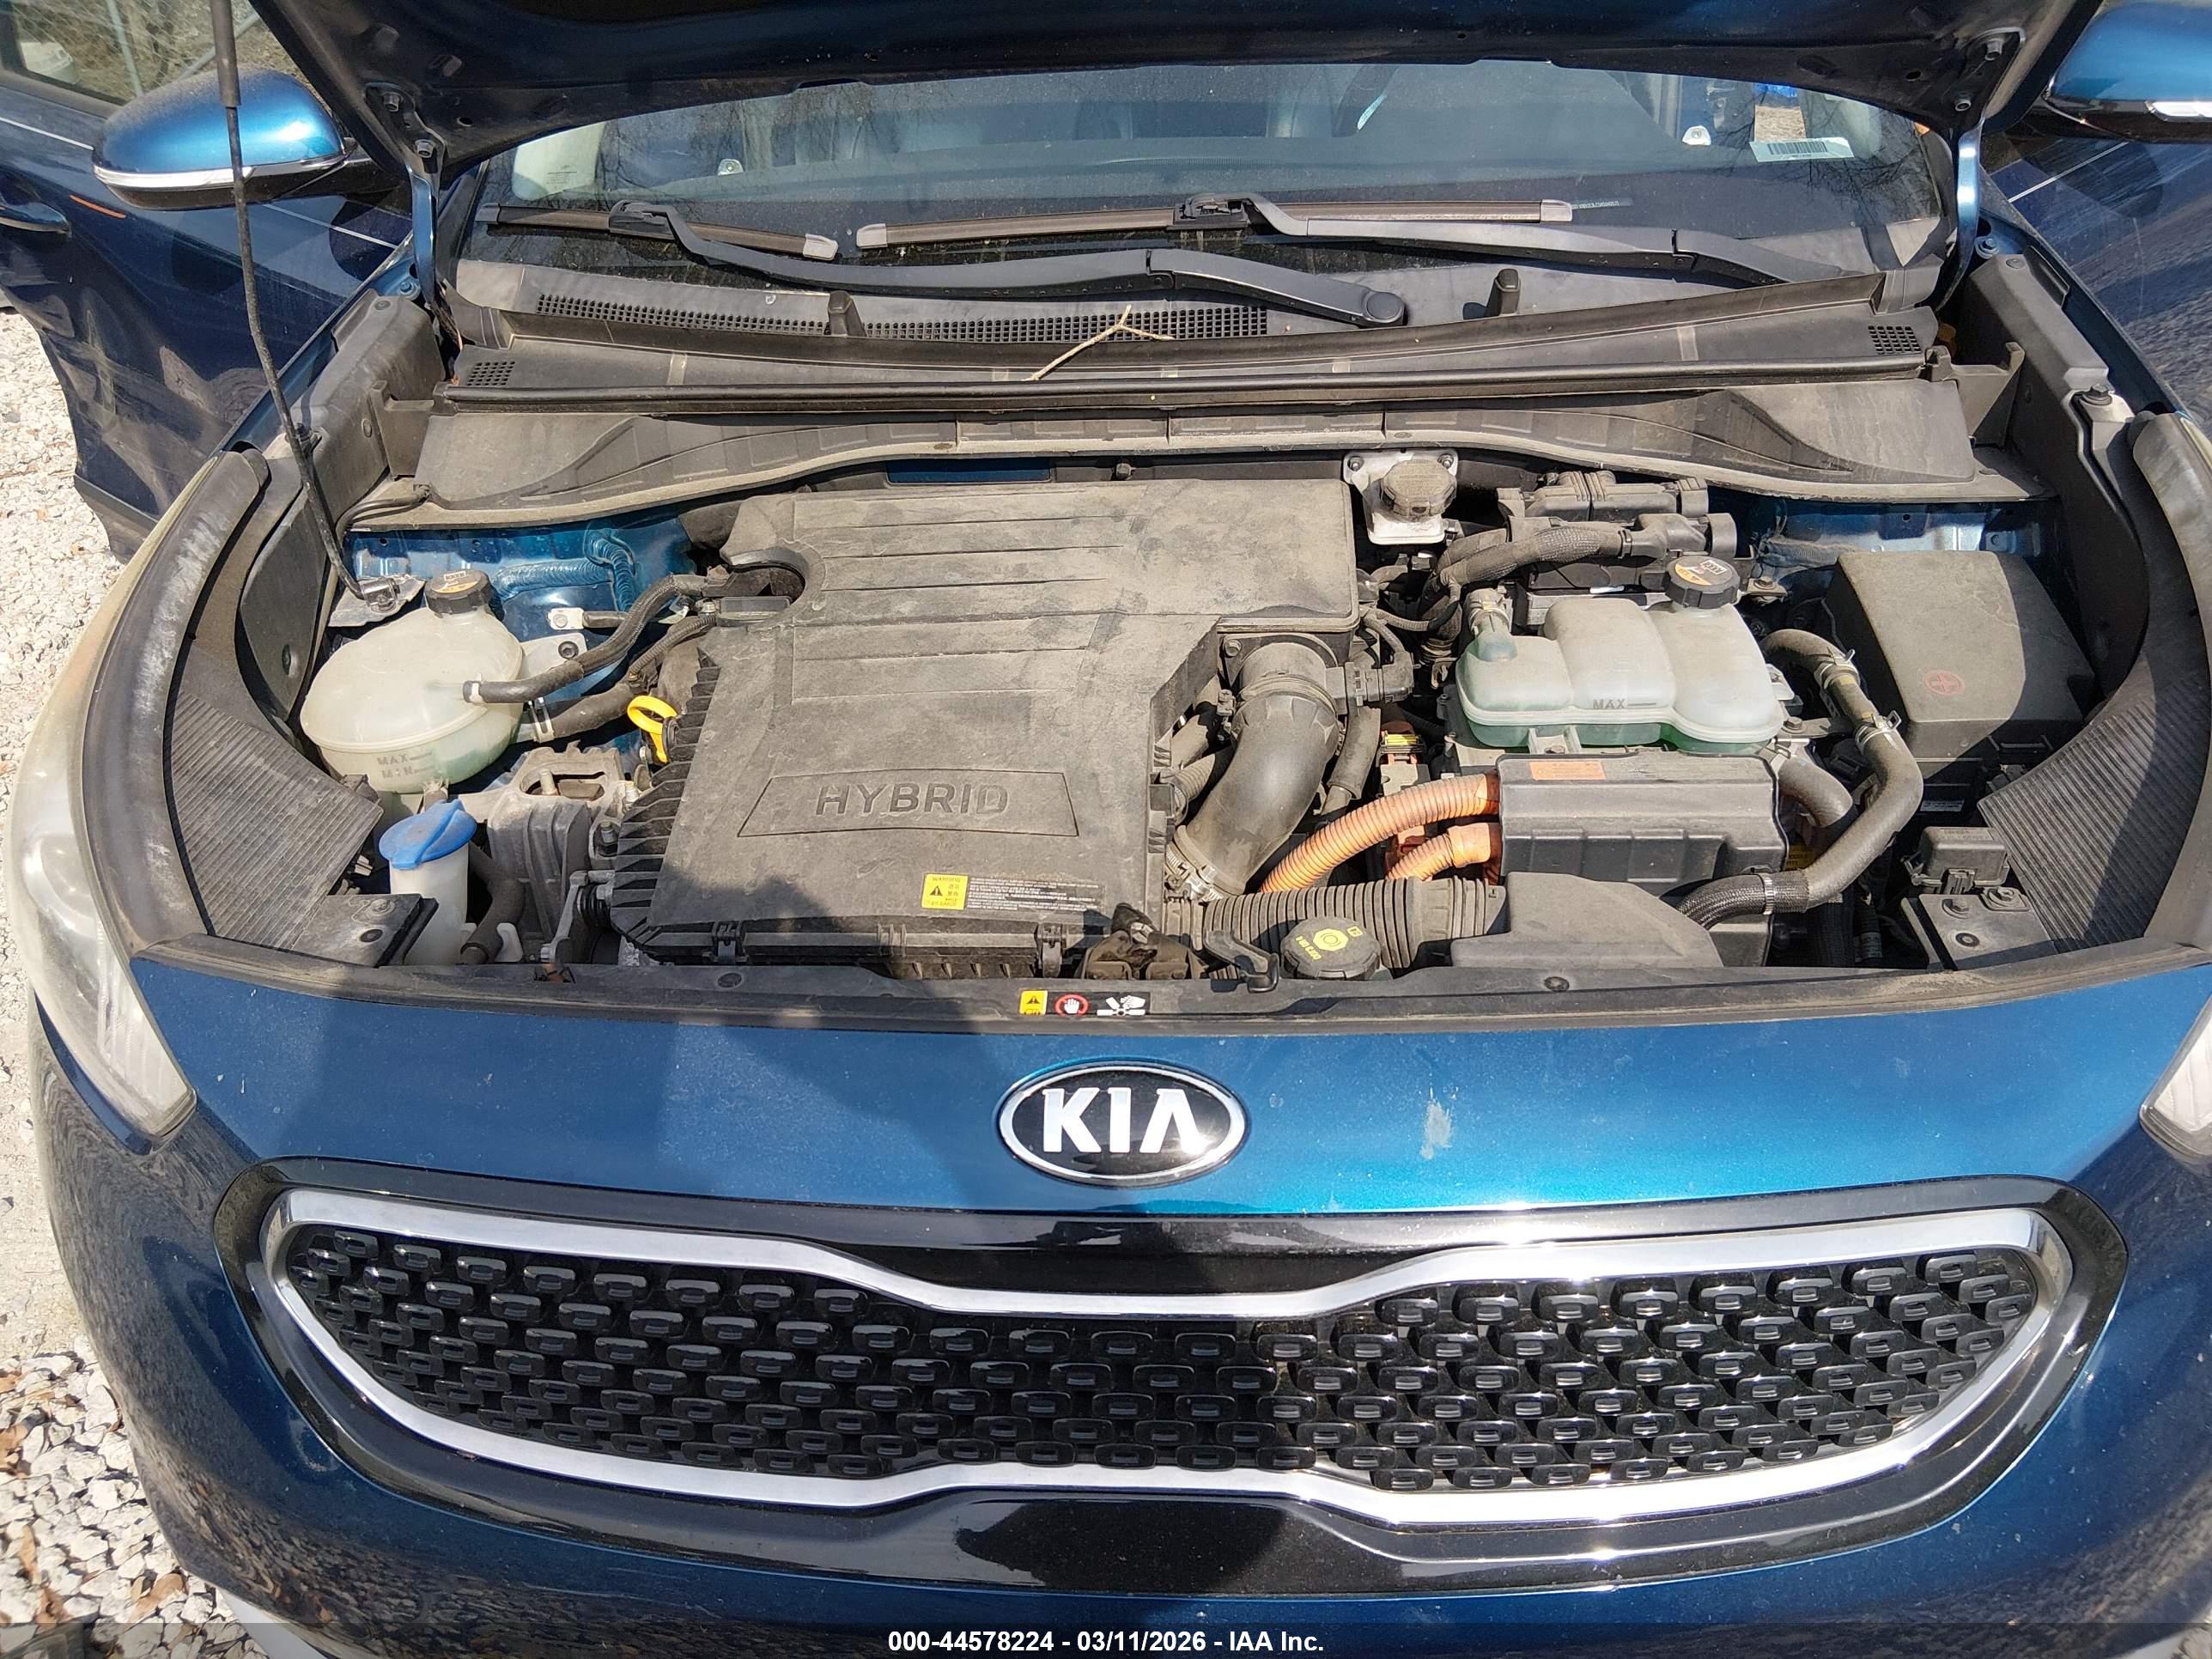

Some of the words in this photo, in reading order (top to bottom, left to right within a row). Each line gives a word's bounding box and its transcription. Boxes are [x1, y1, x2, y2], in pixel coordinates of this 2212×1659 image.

[1593, 698, 1626, 710] MAX
[377, 754, 408, 765] MAX
[382, 766, 413, 779] MIN
[816, 782, 1009, 816] HYBRID
[1042, 1086, 1209, 1155] KIA
